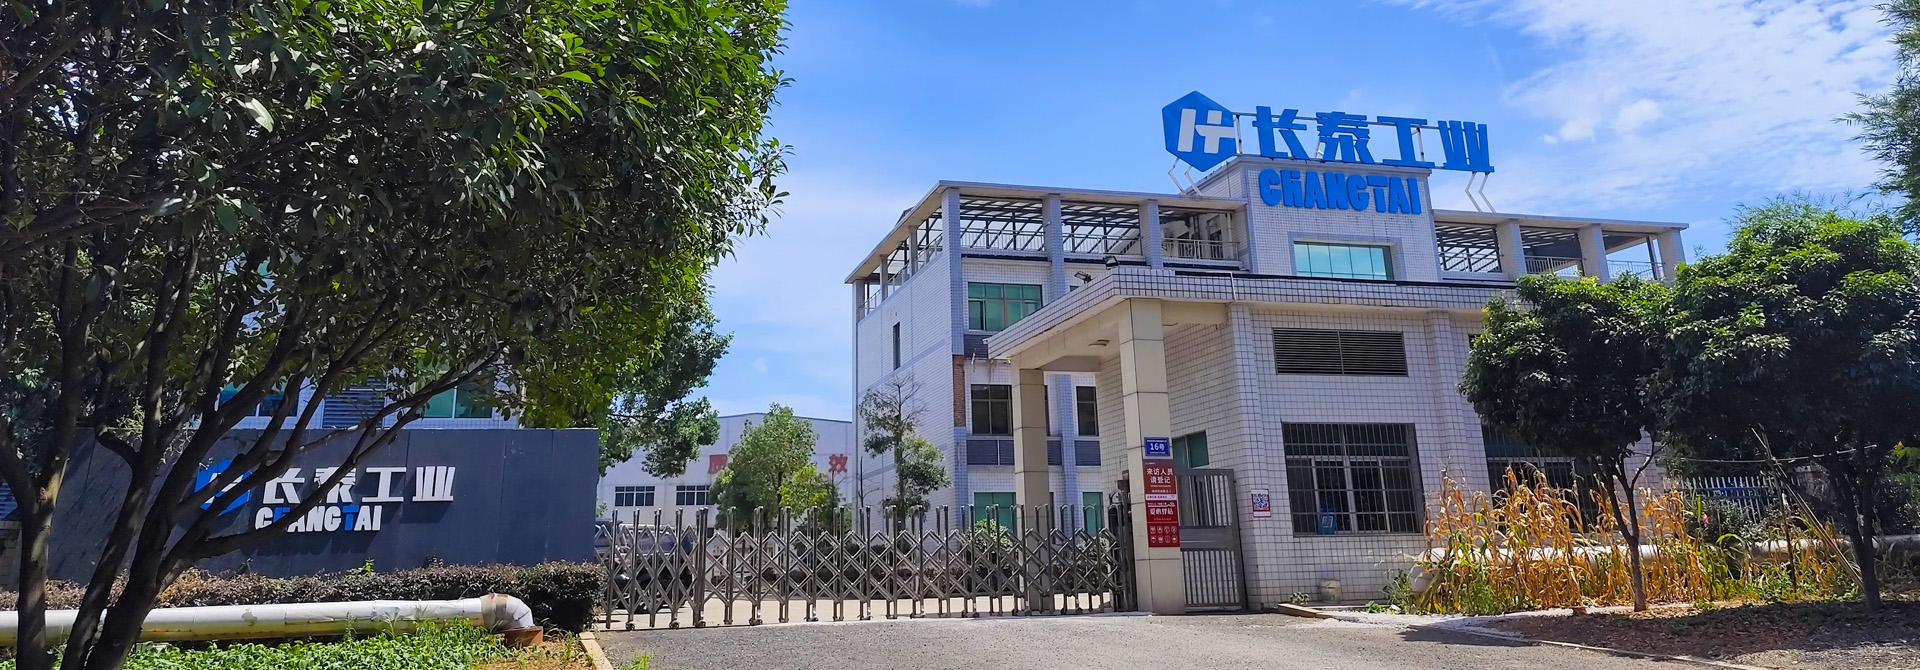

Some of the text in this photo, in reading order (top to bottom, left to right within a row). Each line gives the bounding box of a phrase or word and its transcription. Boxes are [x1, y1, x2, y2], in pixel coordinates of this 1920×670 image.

[1252, 106, 1495, 173] 长泰工业
[1146, 468, 1173, 476] 来访人员
[1150, 476, 1171, 484] 请登记
[262, 466, 456, 504] 长泰工业
